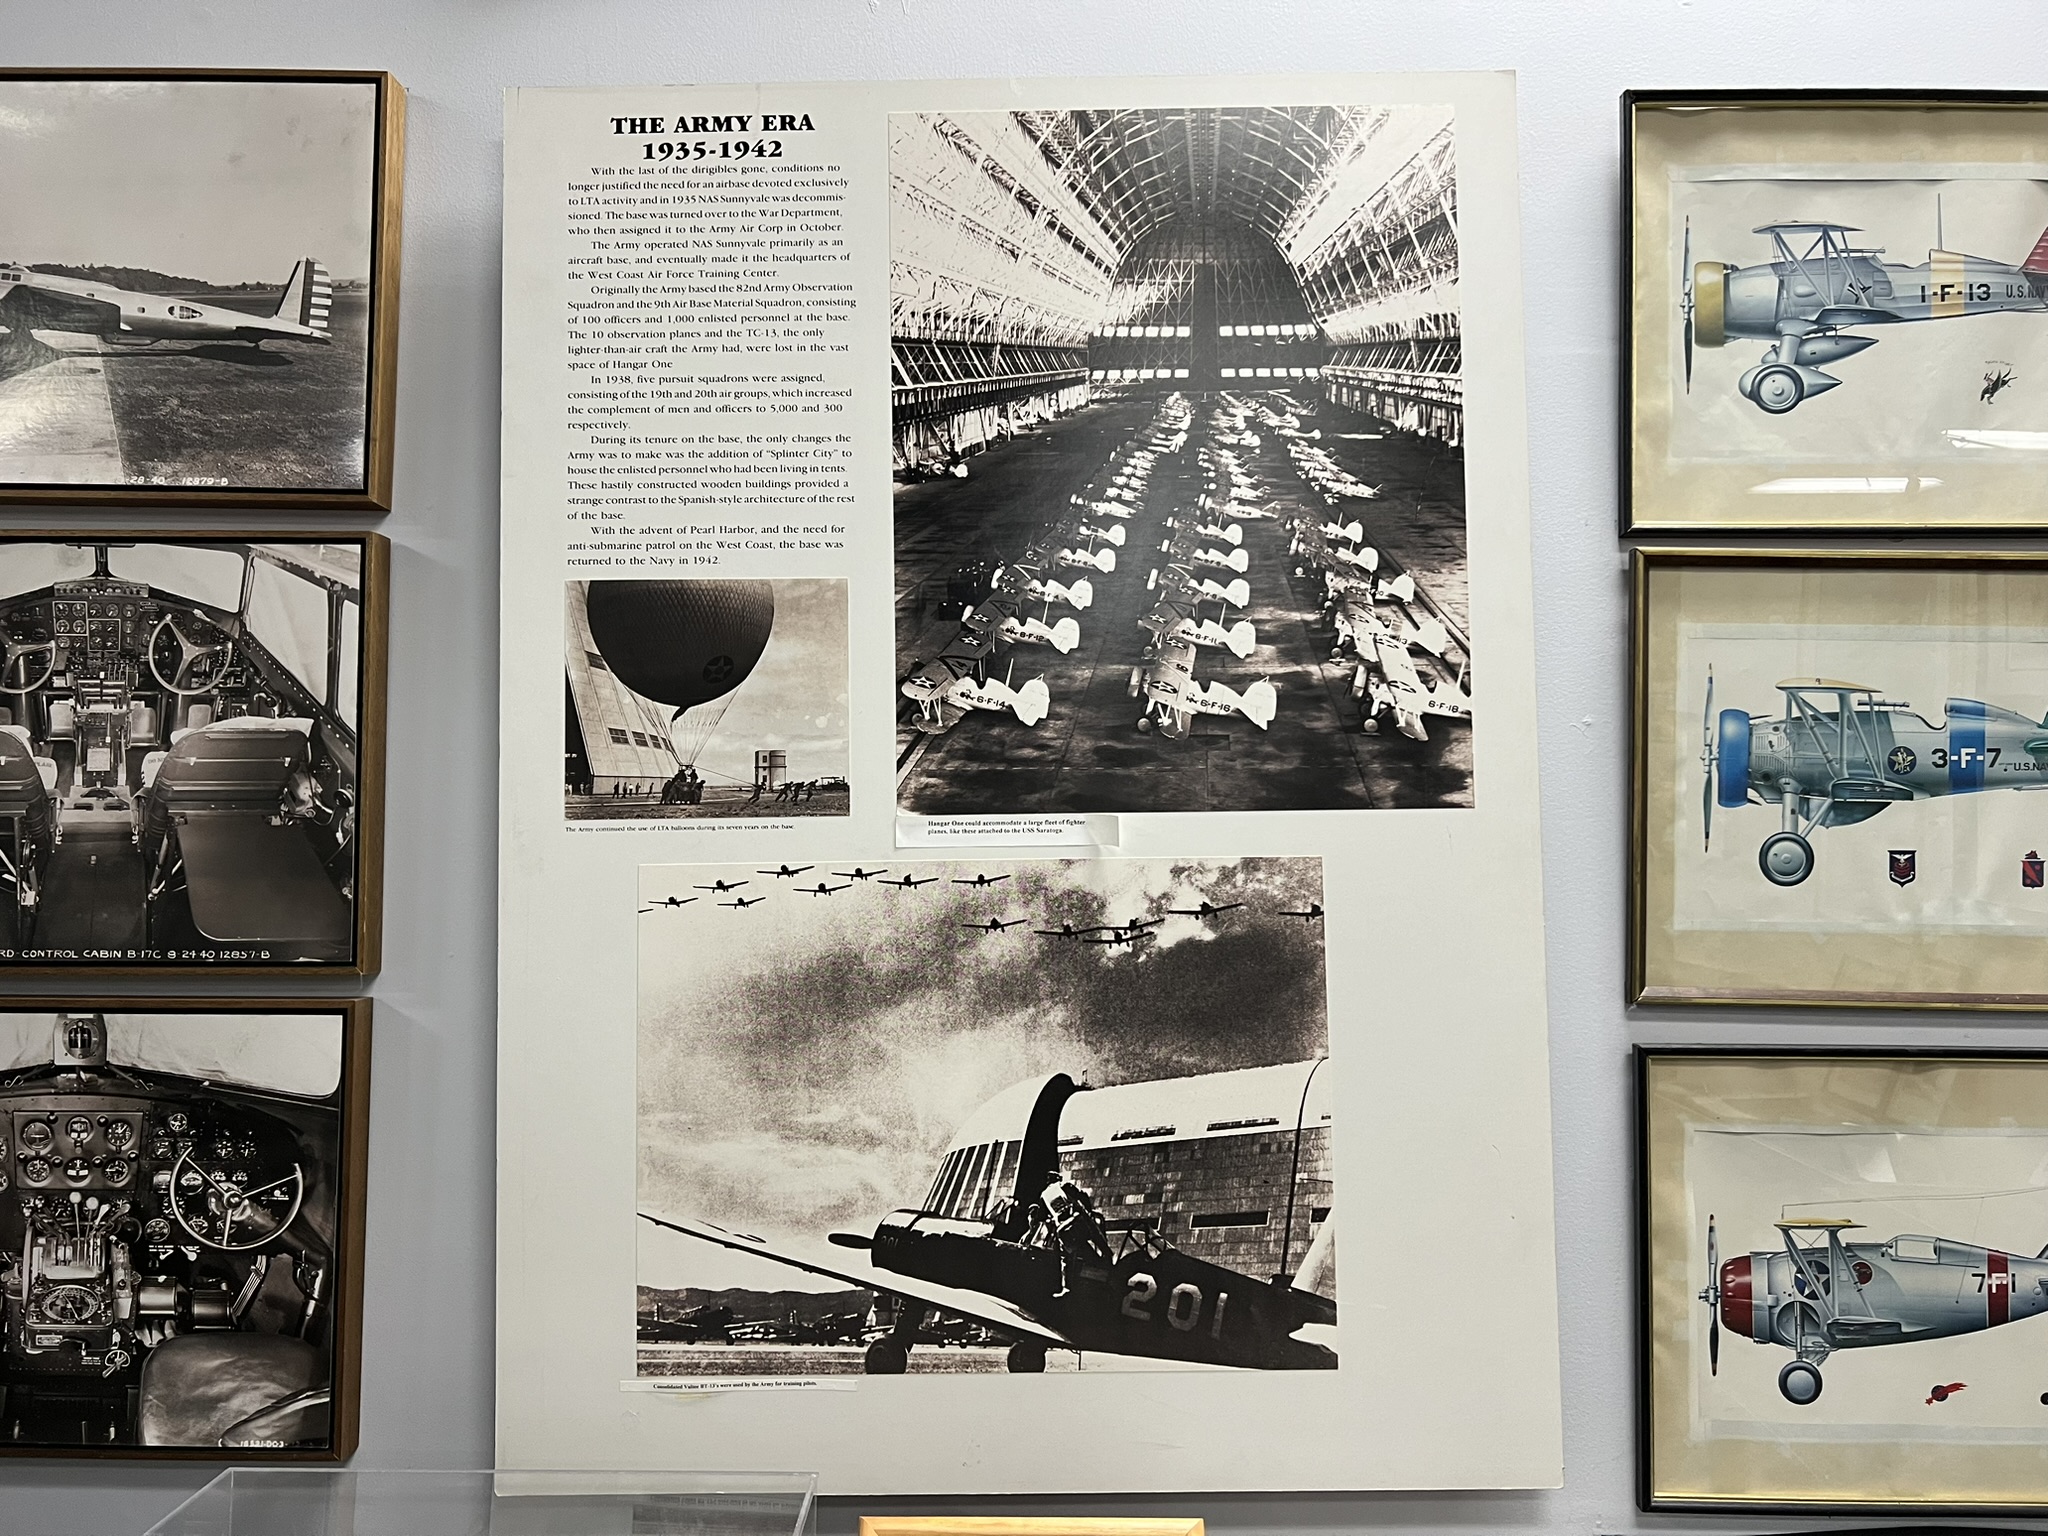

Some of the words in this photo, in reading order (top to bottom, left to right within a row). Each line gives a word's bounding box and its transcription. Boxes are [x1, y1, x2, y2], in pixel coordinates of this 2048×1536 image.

[610, 117, 665, 135] THE
[673, 115, 753, 133] ARMY
[761, 114, 816, 132] ERA
[643, 139, 783, 162] 1935-1942
[591, 167, 615, 176] With
[619, 167, 635, 175] the
[639, 167, 655, 175] last
[659, 166, 669, 175] of
[672, 166, 688, 174] the
[692, 165, 738, 176] dirigibles
[741, 167, 768, 176] gone,
[772, 164, 824, 173] conditions
[568, 182, 600, 193] longer
[602, 181, 641, 192] justified
[643, 181, 659, 190] the
[661, 181, 685, 189] need
[687, 180, 701, 189] for
[716, 180, 750, 188] airbase
[752, 179, 792, 188] devoted
[794, 178, 848, 188] exclusively
[581, 197, 600, 205] LTA
[602, 197, 637, 207] activity
[640, 196, 658, 205] and
[660, 196, 669, 204] in
[673, 195, 697, 204] 1935
[699, 195, 719, 203] NAS
[720, 194, 770, 205] Sunnyvale
[792, 194, 846, 202] decommis-
[568, 212, 603, 220] sioned.
[605, 211, 624, 220] The
[626, 211, 648, 219] base
[670, 210, 703, 219] turned
[741, 209, 757, 218] the
[759, 209, 779, 217] War
[781, 209, 842, 219] Department,
[568, 227, 590, 235] who
[594, 226, 616, 235] then
[620, 226, 661, 237] assigned
[665, 226, 672, 234] it
[690, 225, 706, 234] the
[710, 225, 736, 235] Army
[740, 225, 754, 233] Air
[758, 224, 783, 235] Corp
[787, 224, 796, 232] in
[800, 223, 844, 232] October.
[568, 271, 584, 280] the
[588, 271, 612, 280] West
[617, 271, 644, 279] Coast
[648, 271, 663, 279] Air
[667, 270, 695, 279] Force
[698, 270, 740, 280] Training
[743, 269, 780, 277] Center.
[591, 526, 615, 535] With
[620, 526, 635, 535] the
[639, 526, 673, 535] advent
[677, 526, 687, 534] of
[691, 526, 715, 534] Pearl
[720, 525, 757, 535] Harbor,
[761, 525, 779, 534] and
[783, 525, 799, 534] the
[803, 525, 827, 534] need
[831, 525, 845, 533] for
[568, 541, 642, 550] anti-submarine
[646, 541, 675, 552] patrol
[696, 541, 712, 550] the
[716, 541, 741, 549] West
[745, 541, 776, 550] Coast,
[780, 540, 795, 549] the
[799, 540, 821, 549] base
[568, 557, 611, 566] returned
[630, 556, 646, 565] the
[650, 556, 675, 567] Navy
[679, 557, 689, 565] in
[694, 556, 721, 565] 1942.
[83, 949, 122, 959] CABIN
[127, 949, 161, 959] B-17C
[220, 949, 271, 959] 12857-B
[1121, 1272, 1229, 1340] 201
